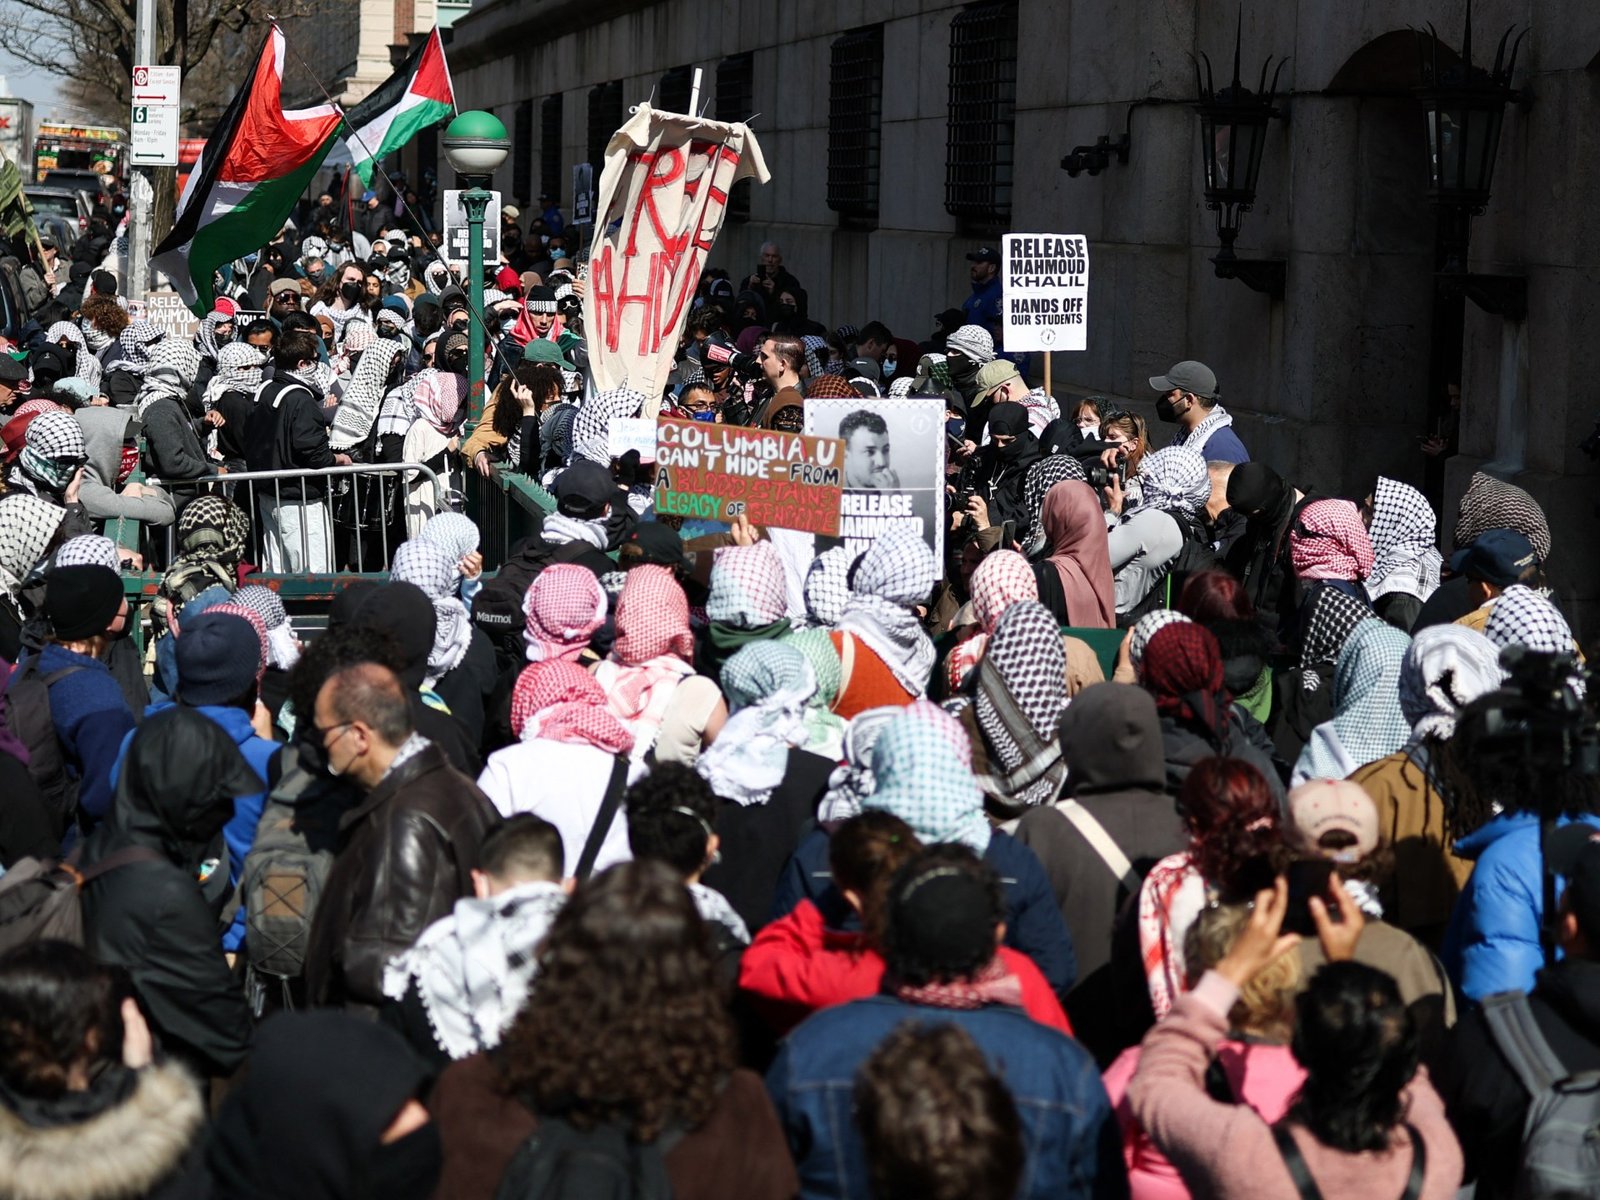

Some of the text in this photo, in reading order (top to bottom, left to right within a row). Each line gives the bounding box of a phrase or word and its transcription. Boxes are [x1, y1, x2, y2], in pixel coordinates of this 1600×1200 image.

[135, 107, 144, 122] 6
[1010, 238, 1085, 258] RELEASE
[1010, 259, 1085, 275] MAHMOUD
[1010, 276, 1085, 287] KHALIL
[150, 296, 187, 309] RELEA
[1011, 297, 1083, 314] HANDS OFF
[1011, 313, 1083, 326] OUR STUDENTS
[656, 446, 722, 471] CAN'T
[725, 454, 770, 479] HIDE
[790, 463, 840, 487] FROM
[655, 467, 672, 490] A
[675, 467, 746, 499] BLOOD
[655, 489, 837, 534] LEGACY OF GENOCIDE
[841, 494, 913, 516] RELEASE
